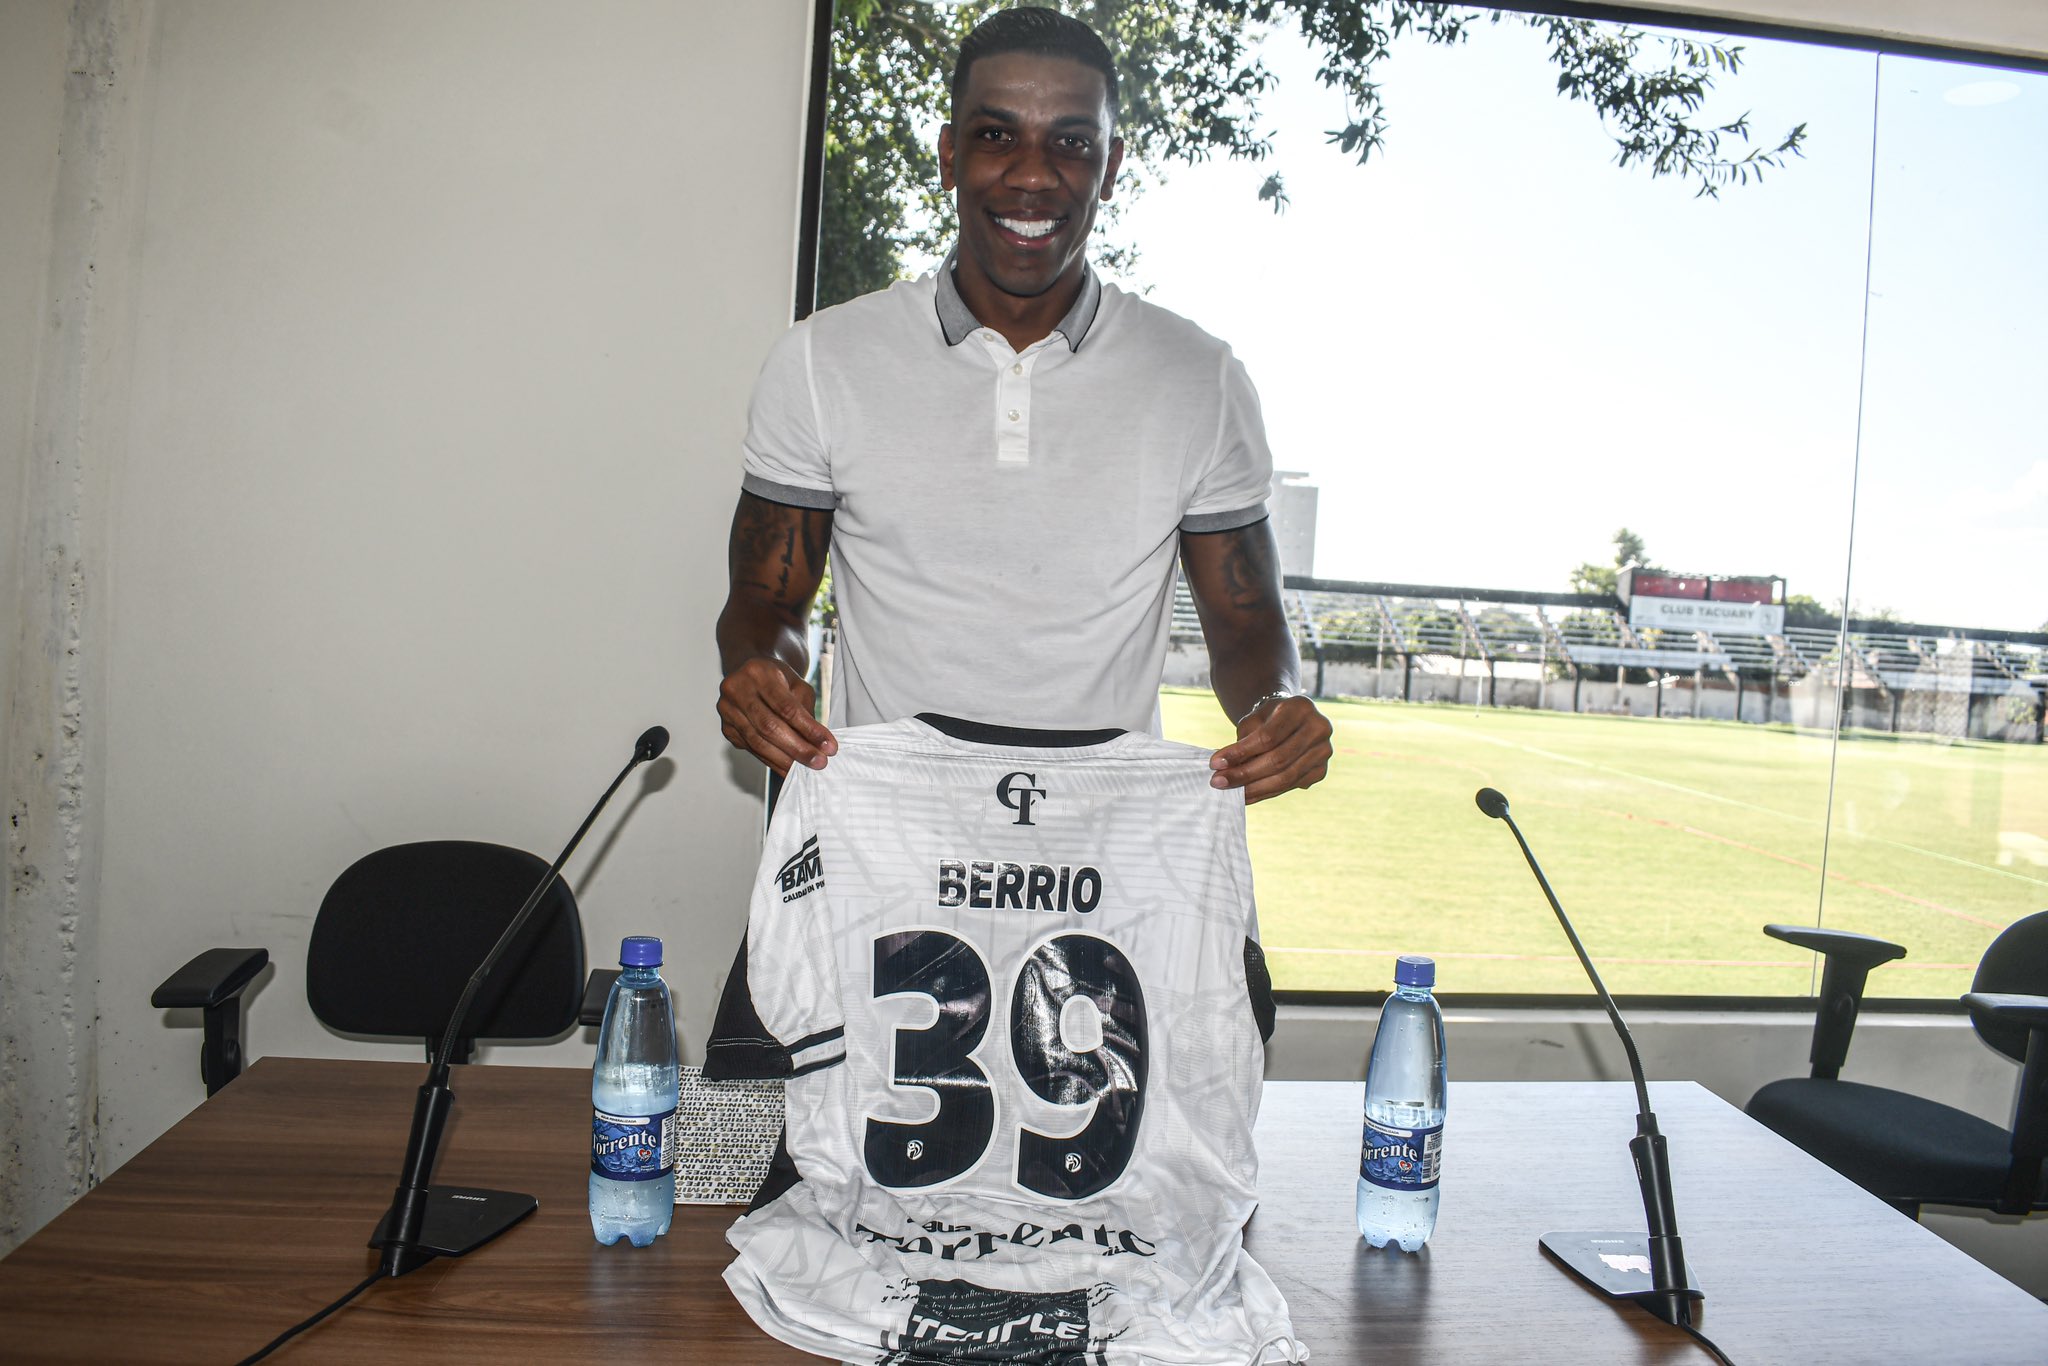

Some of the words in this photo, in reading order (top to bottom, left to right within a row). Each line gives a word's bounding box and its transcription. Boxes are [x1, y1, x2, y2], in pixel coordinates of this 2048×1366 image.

[1661, 603, 1694, 615] CLUB
[1699, 606, 1755, 619] TACUARY
[781, 855, 824, 893] BAM
[937, 858, 1102, 914] BERRIO
[863, 926, 1149, 1200] 39
